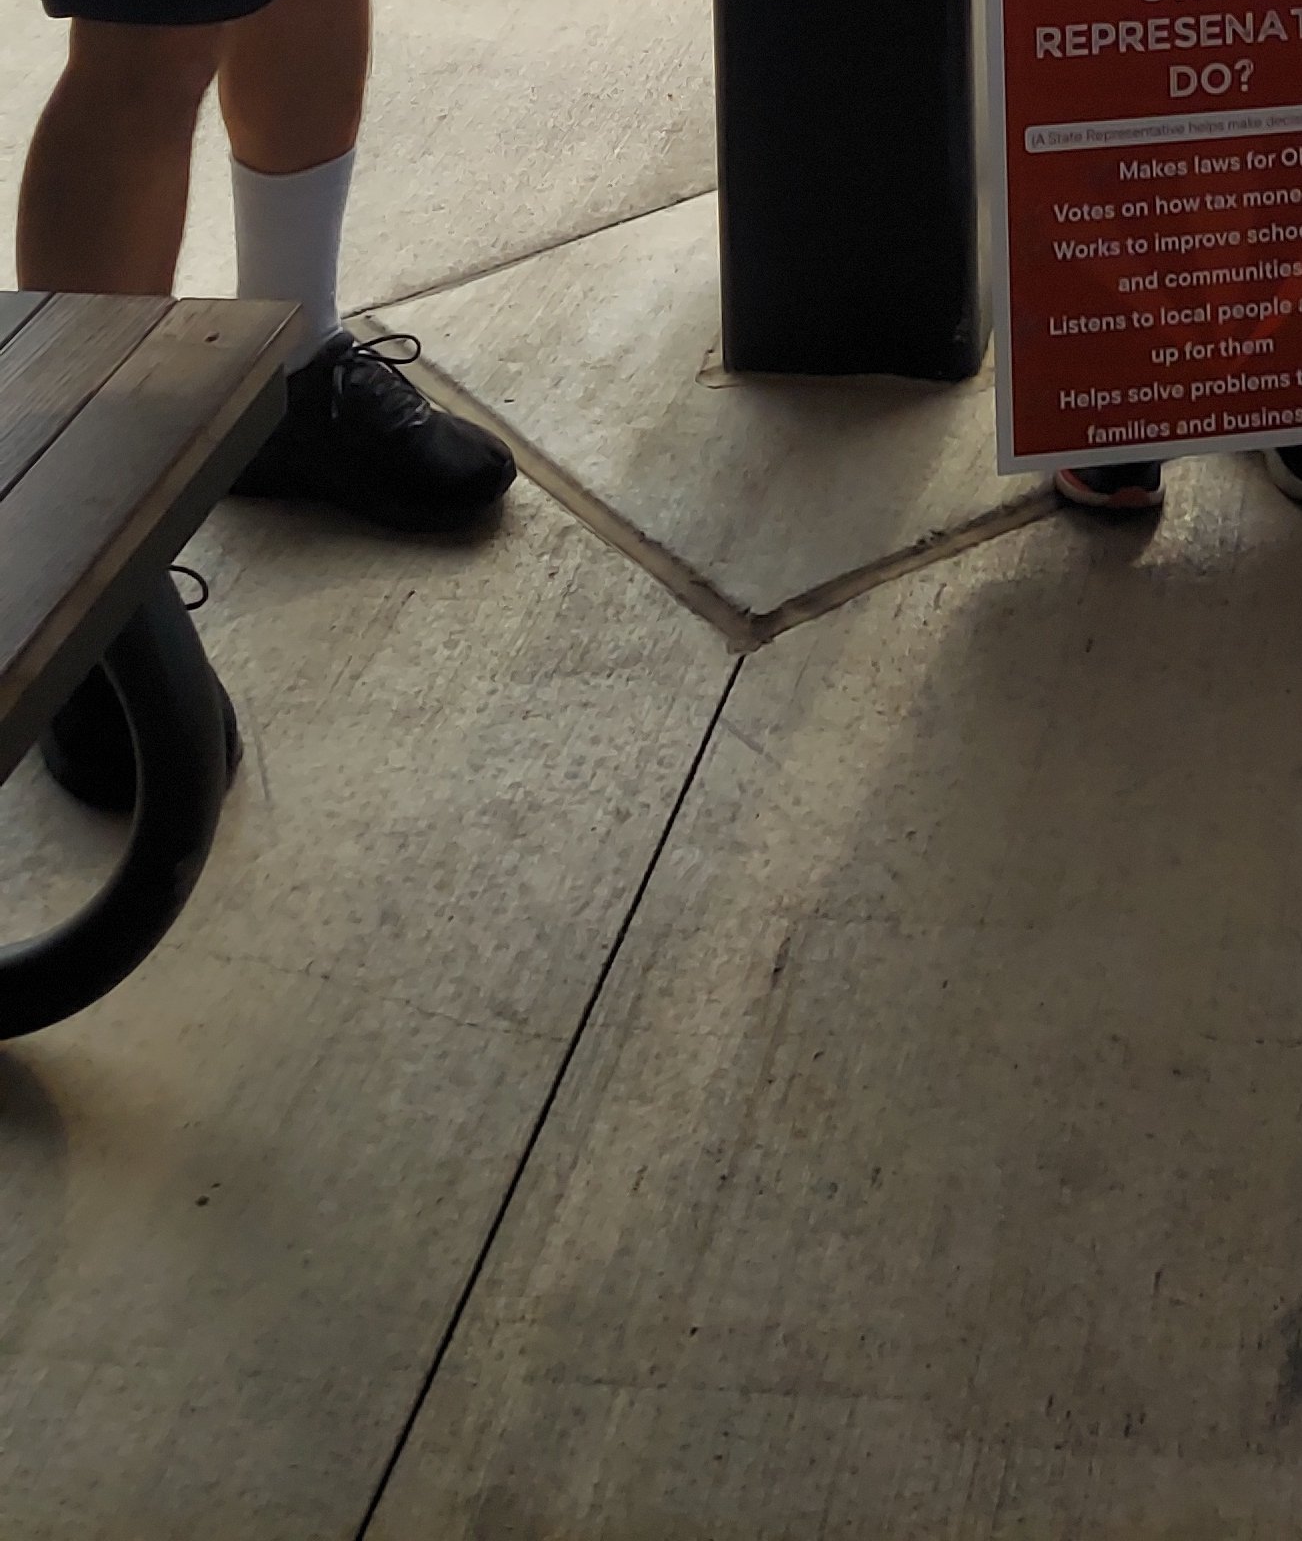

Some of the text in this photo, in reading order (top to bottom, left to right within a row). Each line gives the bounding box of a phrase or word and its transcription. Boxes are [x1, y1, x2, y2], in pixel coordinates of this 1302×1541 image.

[1169, 59, 1254, 98] DO?
[1049, 130, 1083, 147] State
[1188, 120, 1225, 136] helps
[1228, 115, 1263, 131] make
[1119, 159, 1188, 181] Makes
[1194, 155, 1240, 176] laws
[1247, 150, 1276, 169] for
[1053, 203, 1115, 223] Votes
[1121, 201, 1149, 217] on
[1155, 195, 1200, 216] how
[1205, 193, 1237, 211] tax
[1053, 238, 1121, 261] Works
[1127, 237, 1148, 255] to
[1155, 231, 1241, 255] improve
[1118, 258, 1302, 293] and communities
[1050, 314, 1126, 336] Listens
[1131, 310, 1154, 328] to
[1160, 303, 1211, 325] local
[1218, 296, 1292, 324] people
[1151, 337, 1274, 367] up for them
[1059, 387, 1121, 410] Helps
[1128, 381, 1184, 403] solve
[1190, 372, 1291, 401] problems
[1087, 419, 1170, 444] families
[1176, 412, 1216, 435] and
